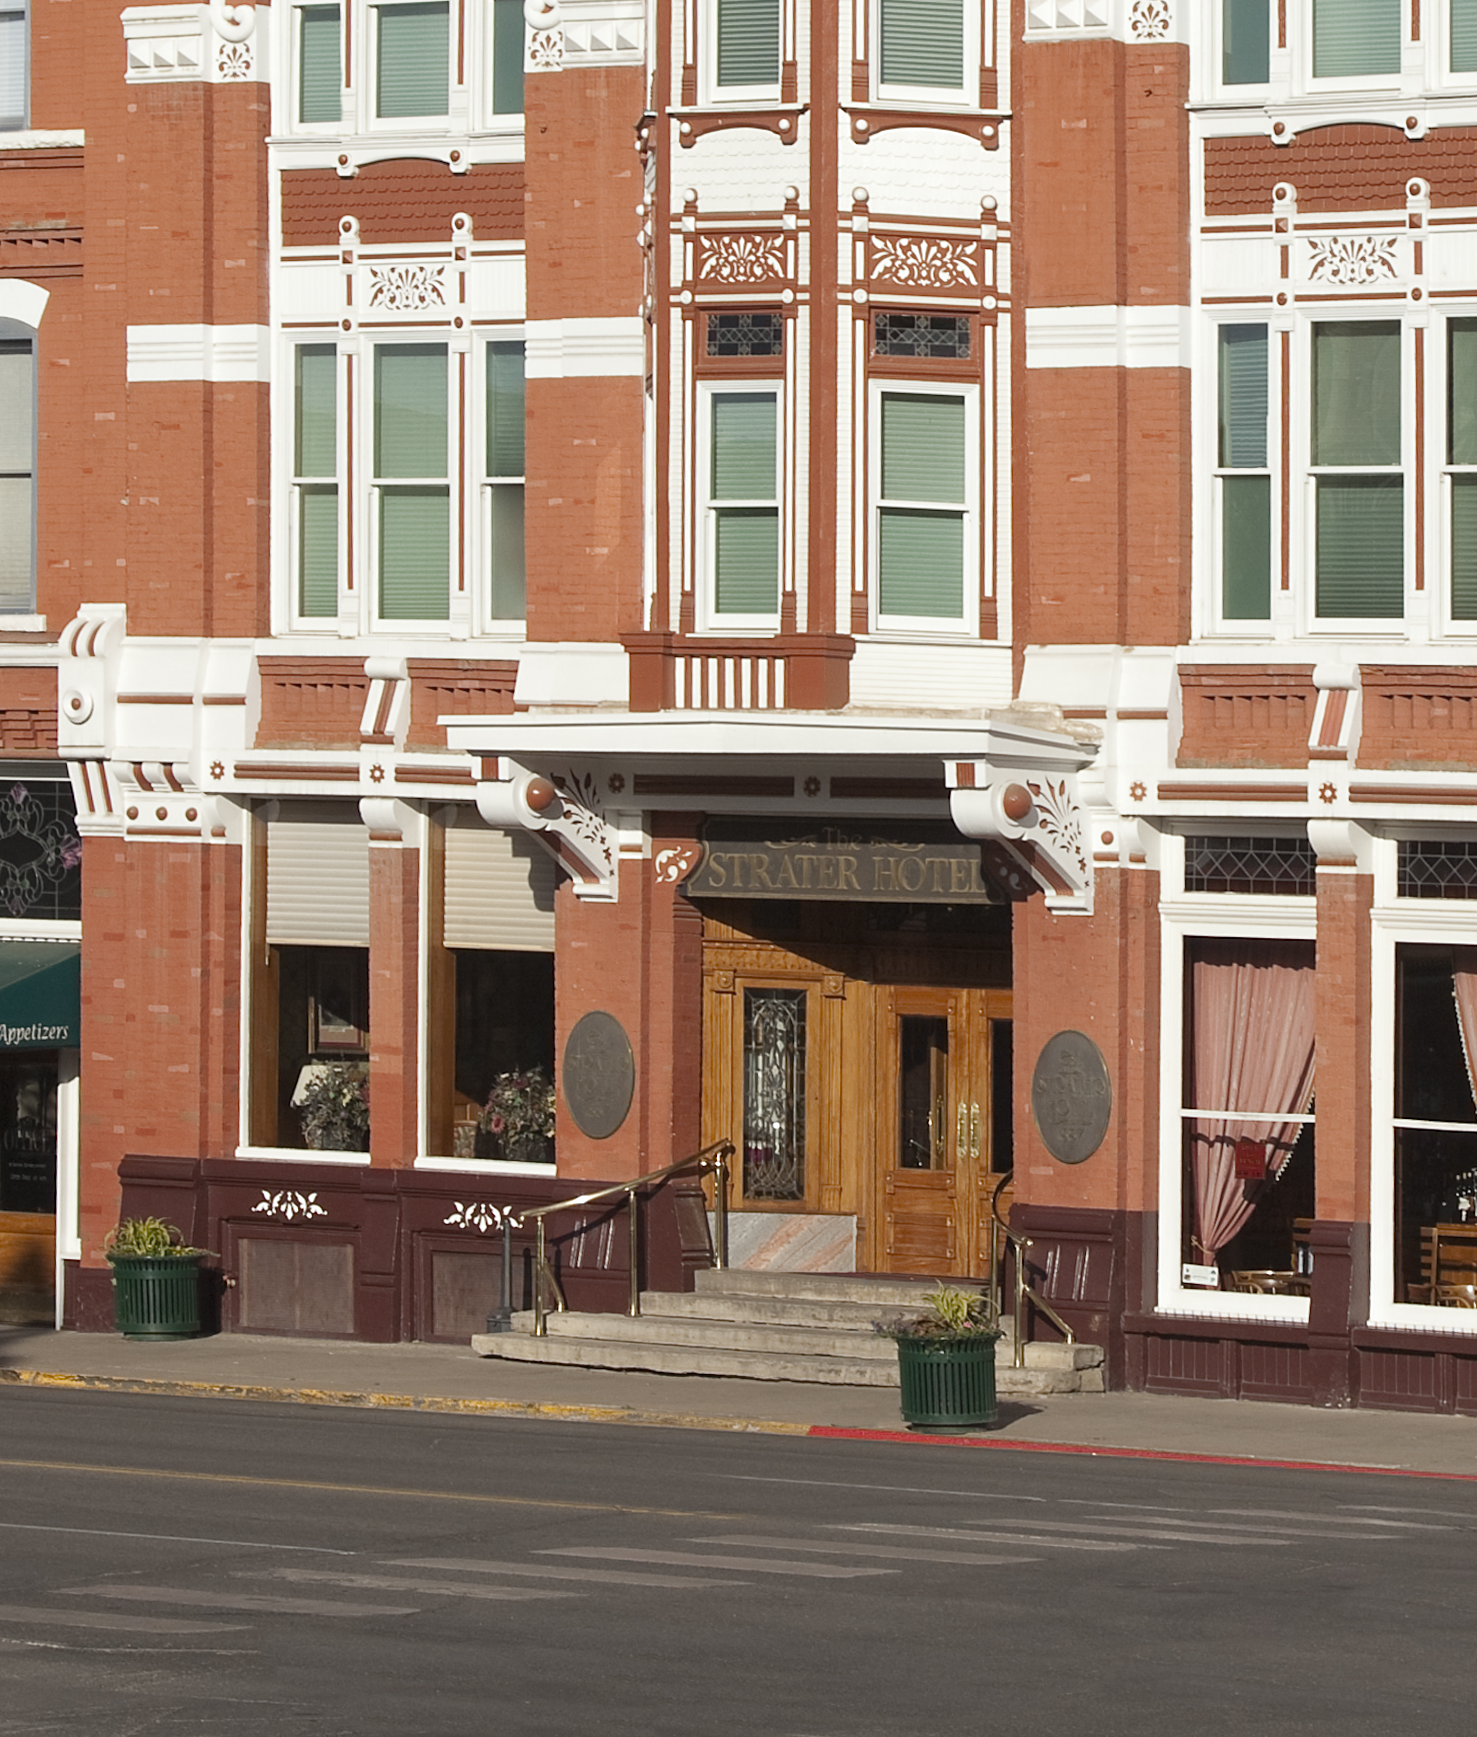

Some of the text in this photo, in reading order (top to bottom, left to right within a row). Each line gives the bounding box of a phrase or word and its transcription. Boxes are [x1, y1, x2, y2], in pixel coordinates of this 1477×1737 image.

[822, 827, 862, 852] The
[708, 852, 987, 894] STRATER HOTEL
